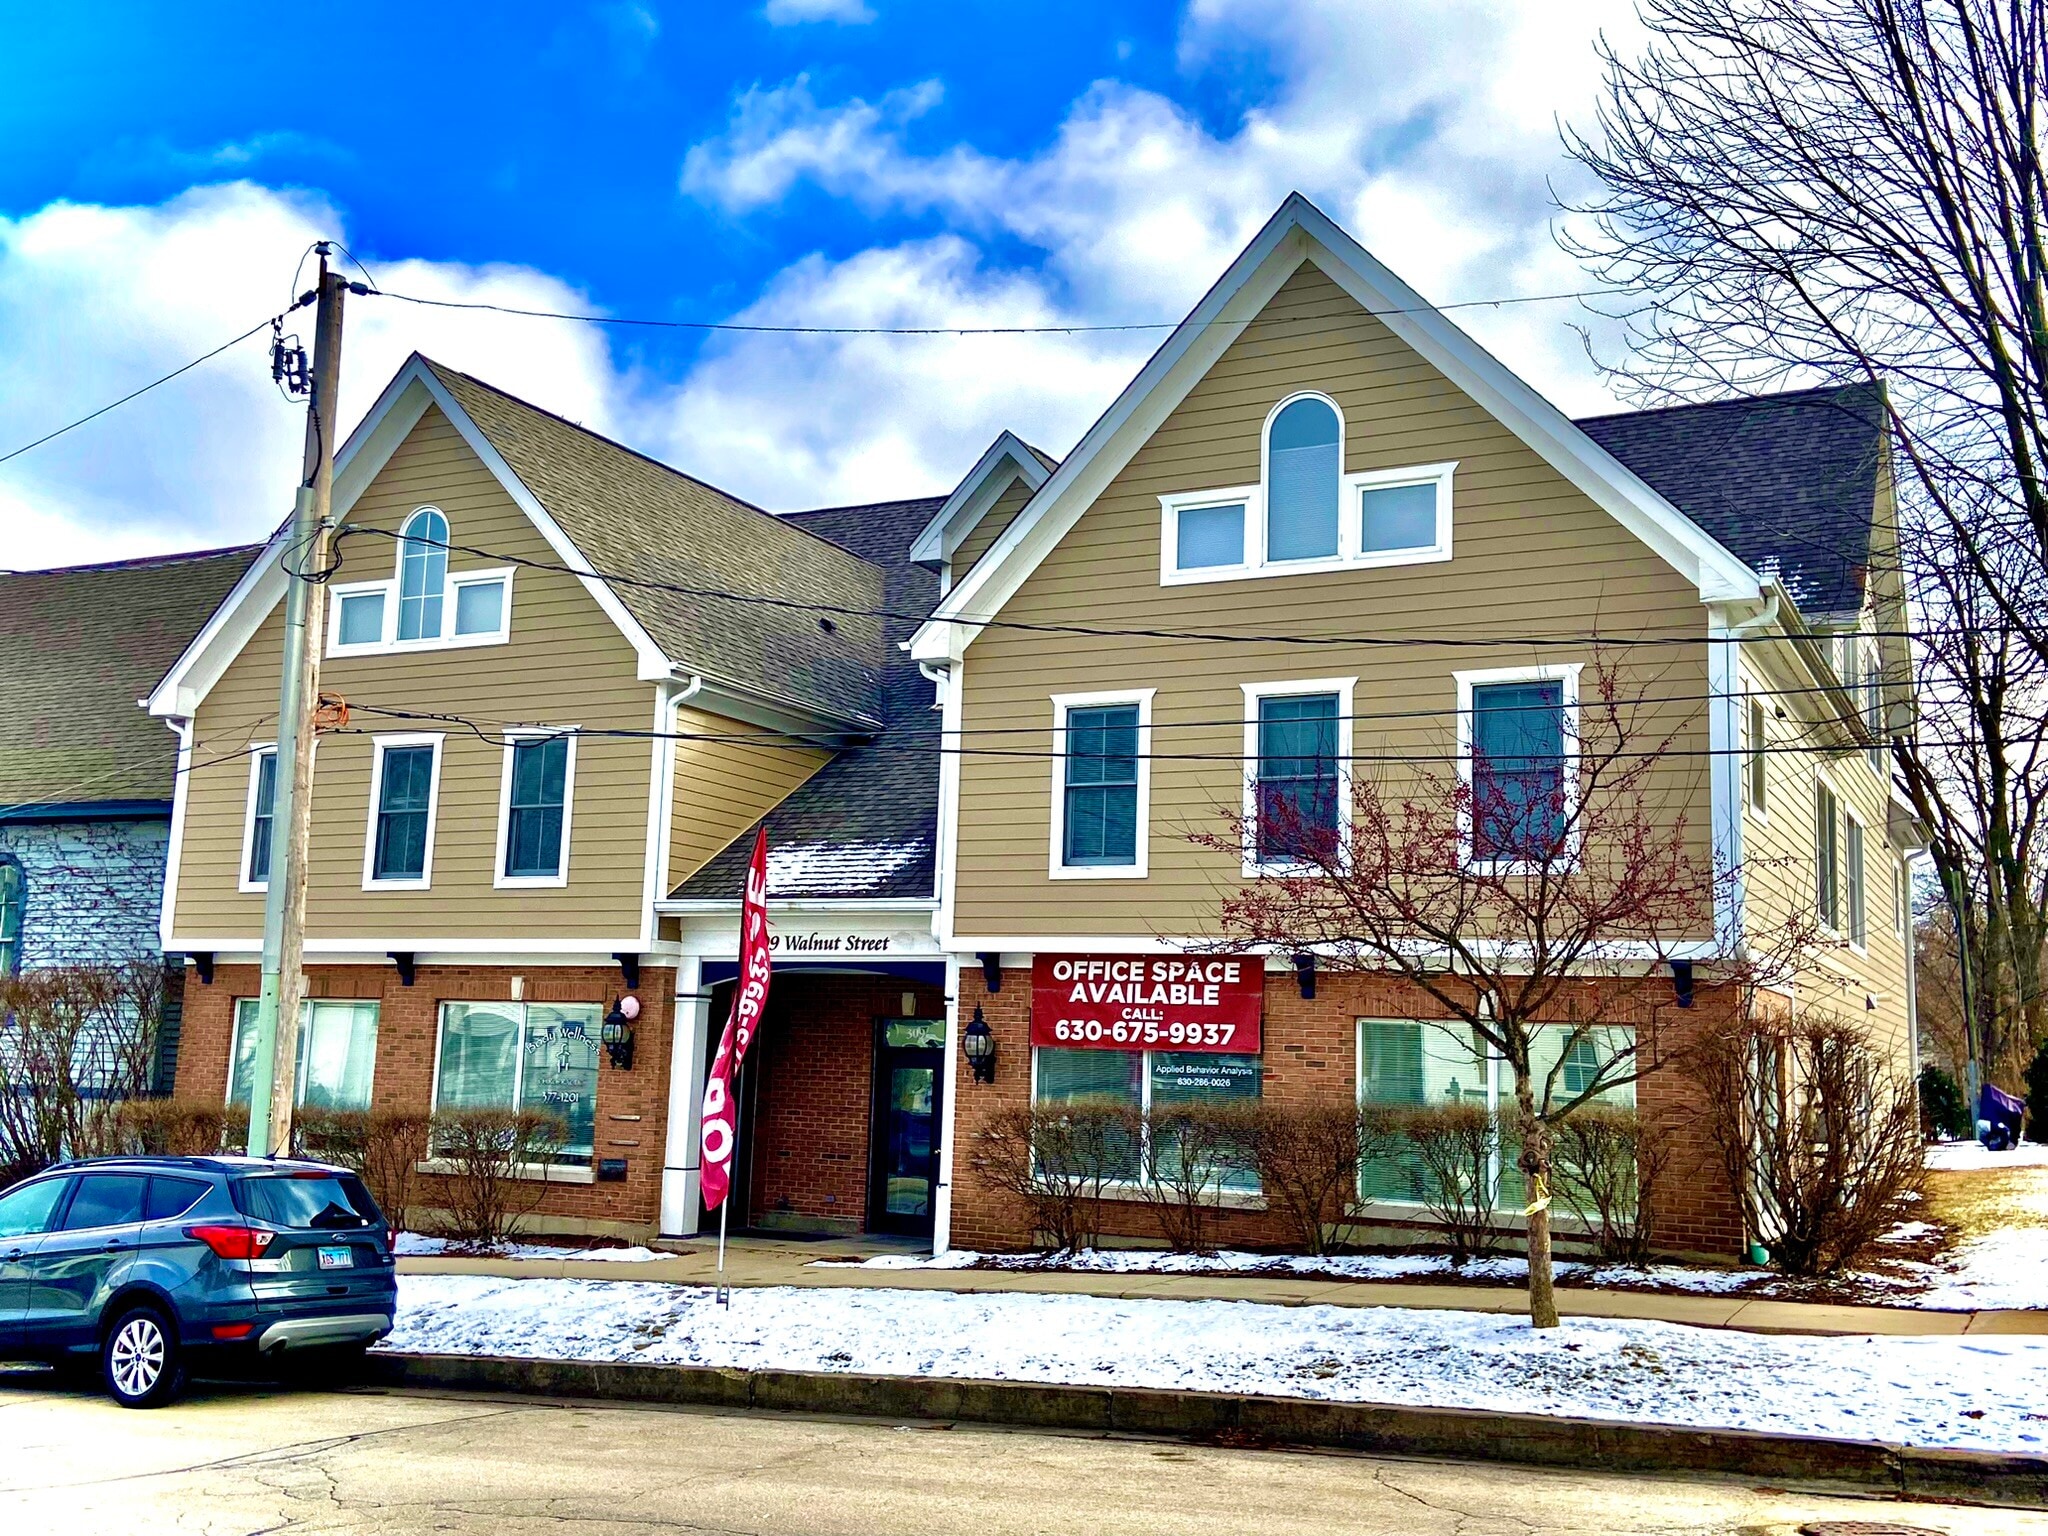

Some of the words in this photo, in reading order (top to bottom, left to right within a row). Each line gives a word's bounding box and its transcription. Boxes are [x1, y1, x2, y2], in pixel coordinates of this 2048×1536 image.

[784, 931, 842, 951] Walnut
[845, 934, 891, 951] Street
[1052, 960, 1145, 982] OFFICE
[1151, 961, 1241, 983] SPACE
[1068, 982, 1220, 1005] AVAILABLE
[1121, 1007, 1164, 1021] CALL:
[525, 1028, 556, 1054] Body
[558, 1025, 601, 1056] Wellness
[906, 1028, 926, 1040] 309
[1055, 1019, 1236, 1046] 630-675-9937
[1155, 1064, 1185, 1075] Applied
[1186, 1065, 1219, 1074] Behavior
[1220, 1066, 1253, 1077] Analysis
[542, 1091, 579, 1103] 377-1201
